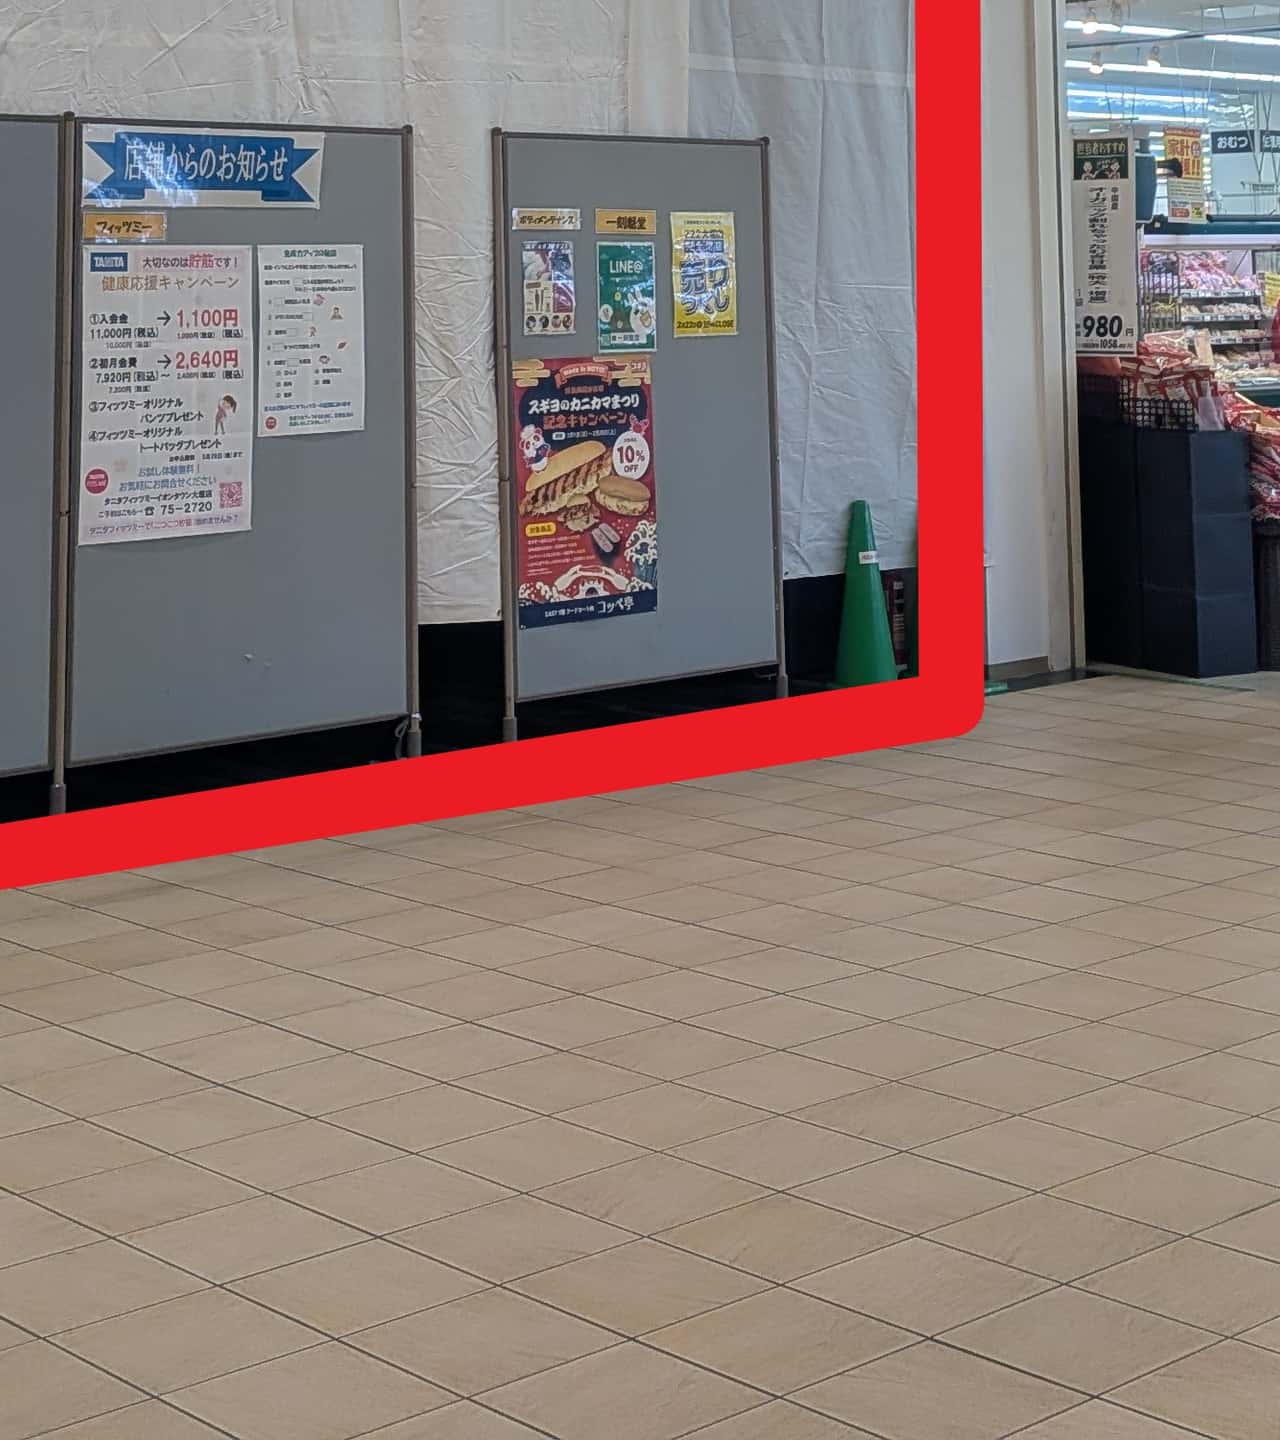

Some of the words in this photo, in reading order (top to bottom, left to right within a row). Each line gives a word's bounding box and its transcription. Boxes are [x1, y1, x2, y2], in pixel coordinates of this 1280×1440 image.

[1216, 135, 1248, 150] おむつ
[123, 142, 288, 182] 店舗からのお知らせ
[609, 260, 643, 274] LINE@
[176, 309, 239, 329] 1,100円
[1083, 315, 1123, 337] 980
[175, 350, 239, 370] 2,640円
[527, 393, 640, 414] スギヨのカニカマまつり
[543, 413, 628, 430] 記念キャンペーン
[616, 445, 646, 465] 10%
[623, 463, 639, 474] OFF
[160, 502, 213, 515] 75-2720
